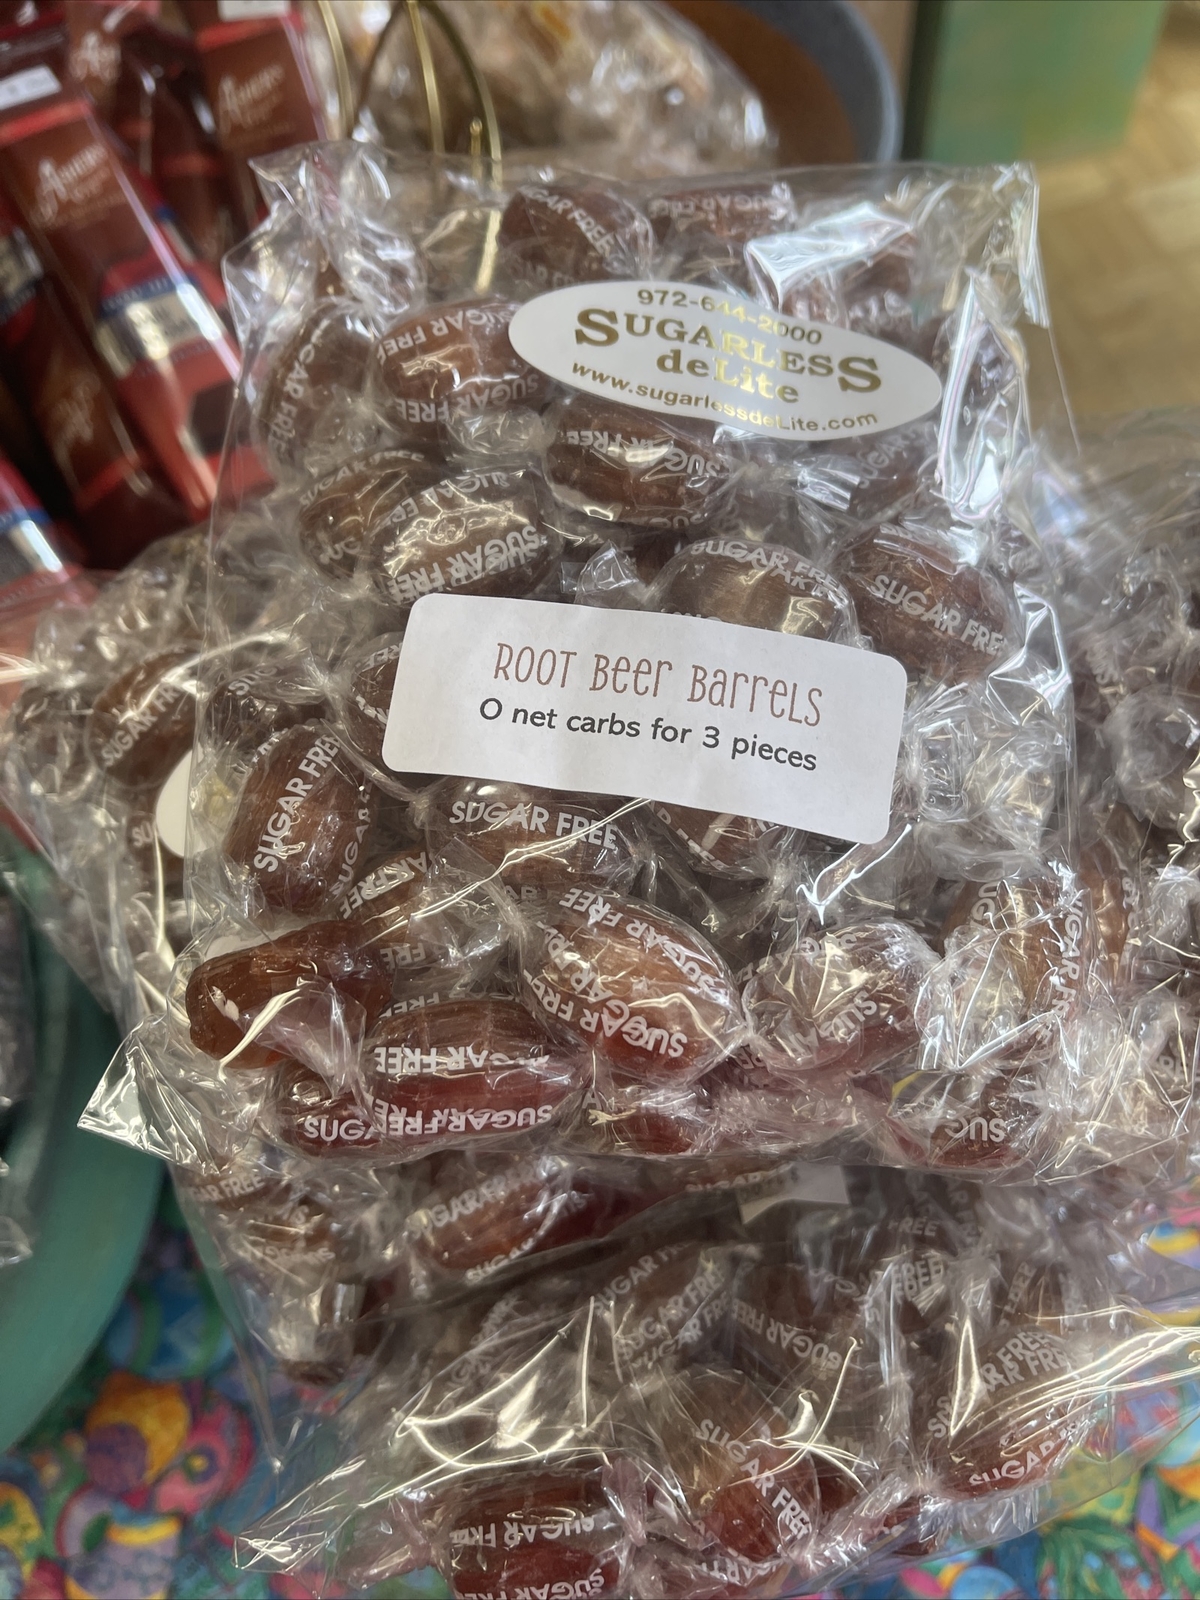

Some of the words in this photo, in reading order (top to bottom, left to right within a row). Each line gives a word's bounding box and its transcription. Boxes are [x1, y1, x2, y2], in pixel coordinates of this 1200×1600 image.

[637, 288, 823, 345] 972-644-2000
[574, 306, 882, 394] SUGARLESS
[566, 430, 623, 457] FREE
[873, 574, 962, 635] SUGAR
[493, 641, 577, 689] ROOT
[512, 706, 557, 730] net
[566, 712, 641, 739] carbs
[651, 717, 693, 746] for
[702, 726, 721, 749] 3
[731, 734, 818, 771] pieces
[253, 777, 313, 873] SUGAR
[449, 800, 549, 834] SUGAR
[558, 887, 624, 926] FREE
[580, 1007, 688, 1058] SUGAR
[374, 1046, 438, 1075] FREE
[447, 1103, 553, 1132] SUGAR
